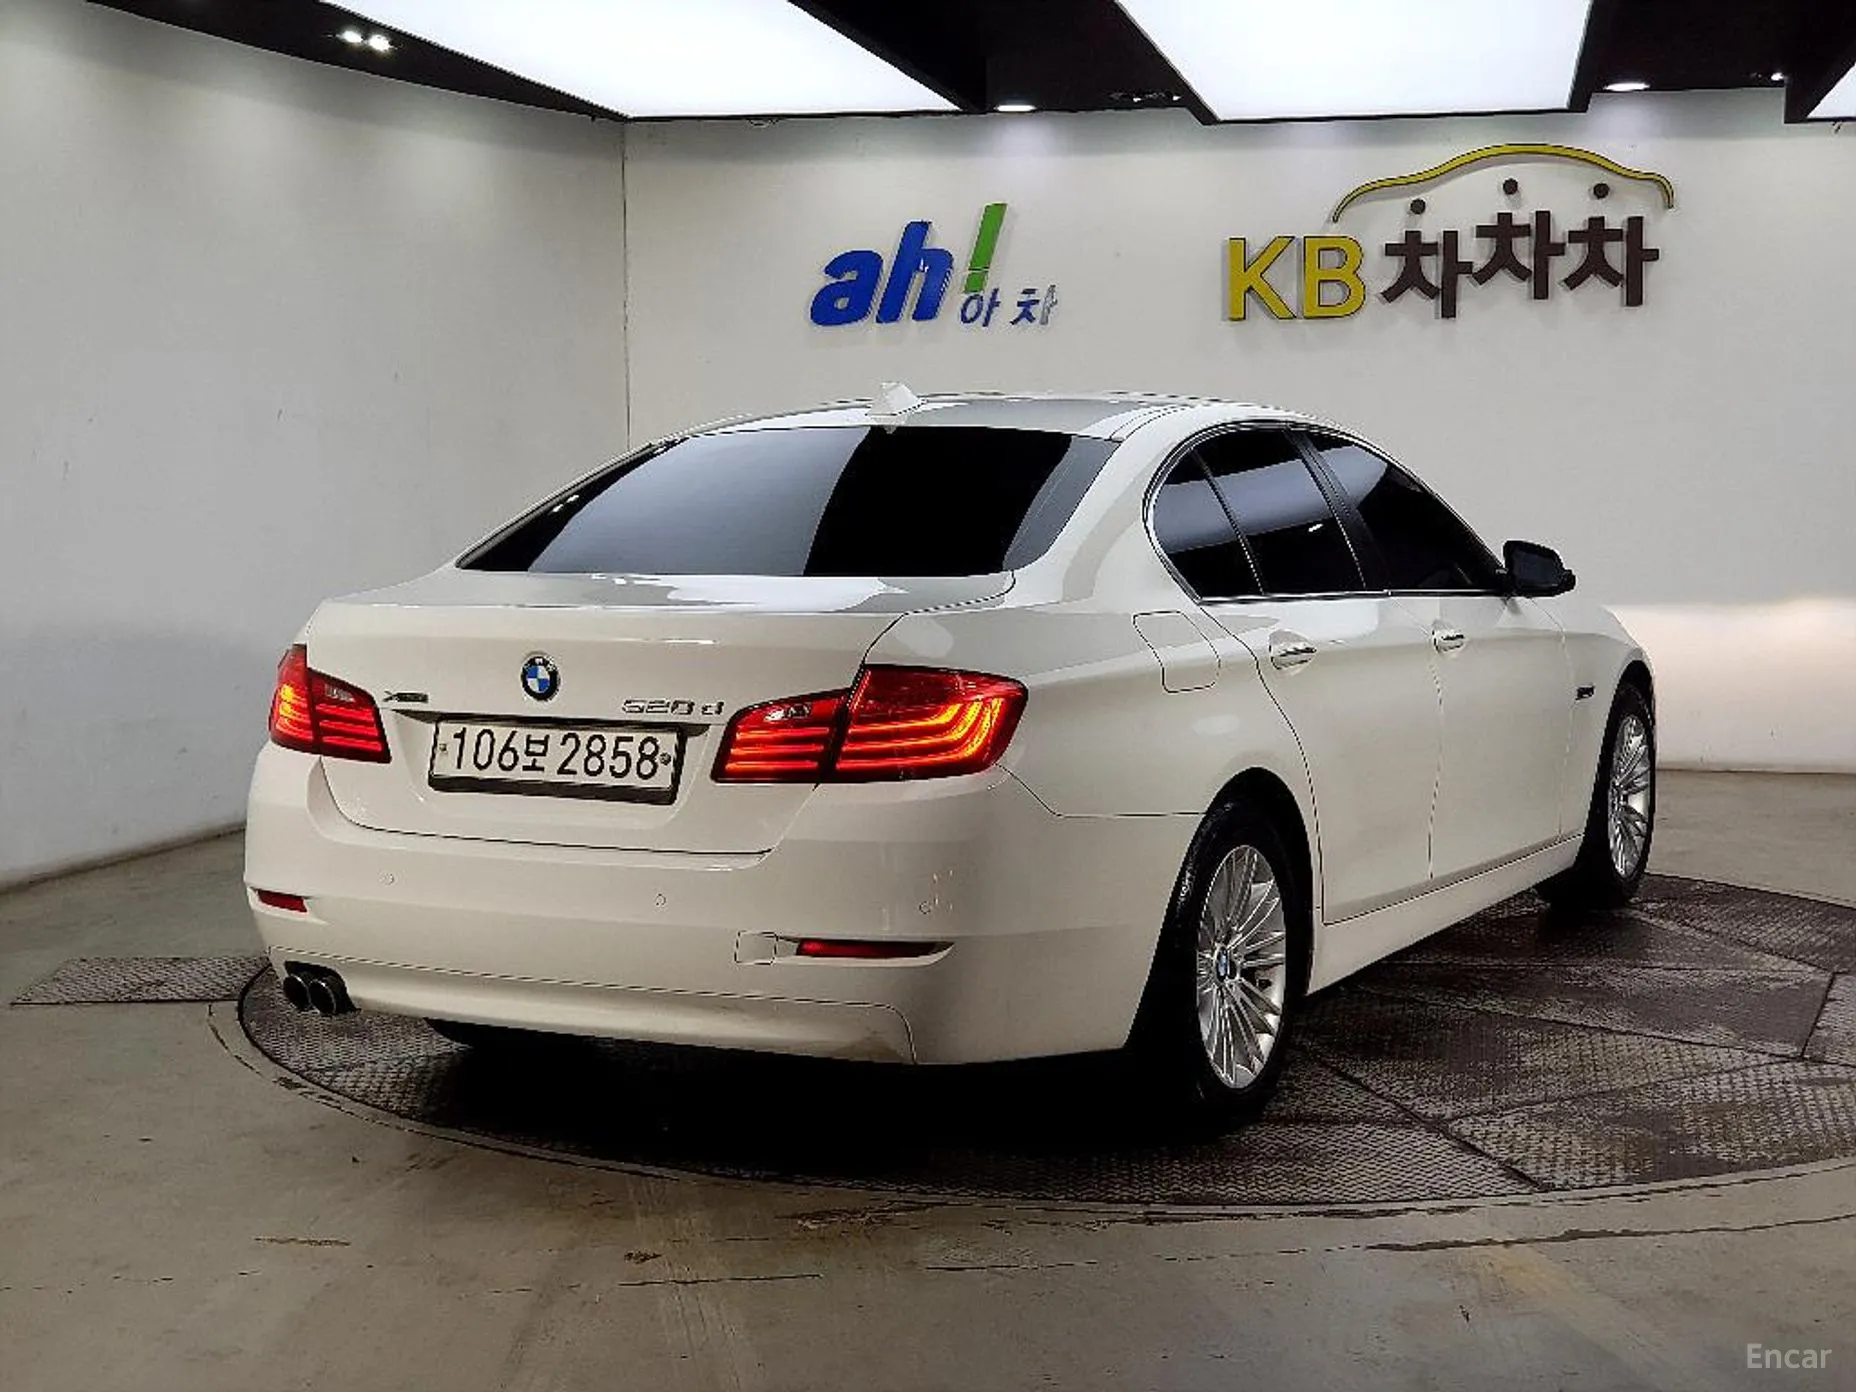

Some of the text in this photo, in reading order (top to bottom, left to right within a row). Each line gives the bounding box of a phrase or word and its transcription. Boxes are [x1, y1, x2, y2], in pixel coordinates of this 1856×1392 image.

[810, 203, 1008, 326] ah!
[1229, 177, 1660, 321] KB 차차차
